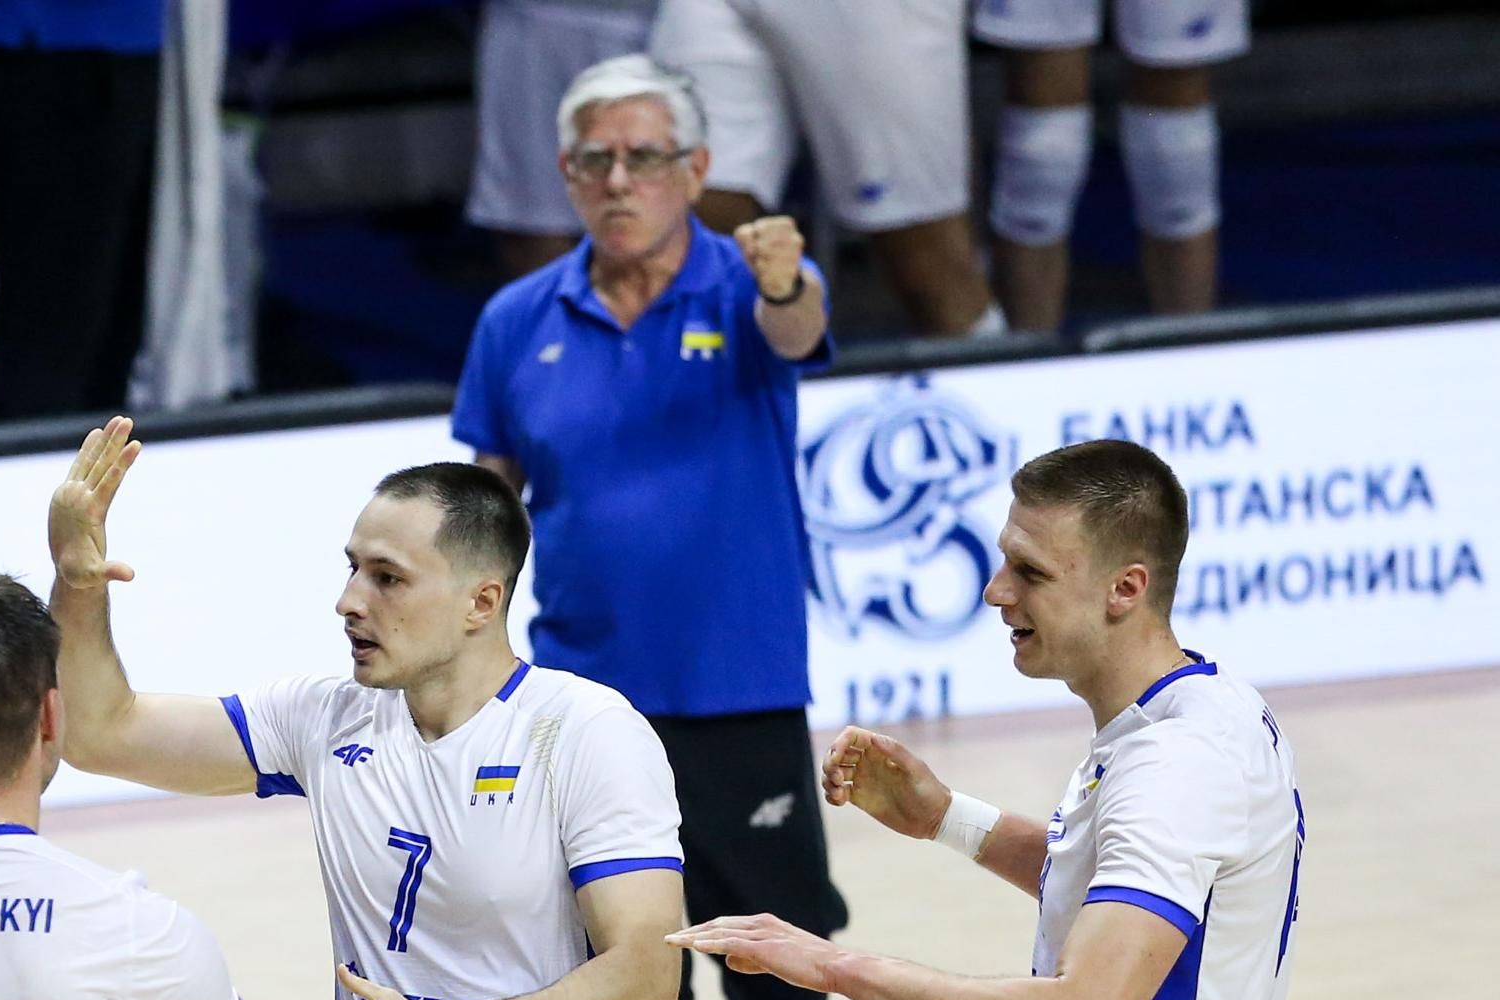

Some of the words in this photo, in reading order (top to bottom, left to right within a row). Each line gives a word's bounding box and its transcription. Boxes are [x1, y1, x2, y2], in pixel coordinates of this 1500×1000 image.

[1188, 464, 1436, 536] ТАНСКА
[1172, 540, 1485, 622] ДИОНИЦА
[846, 671, 950, 724] 1921
[386, 826, 432, 953] 7
